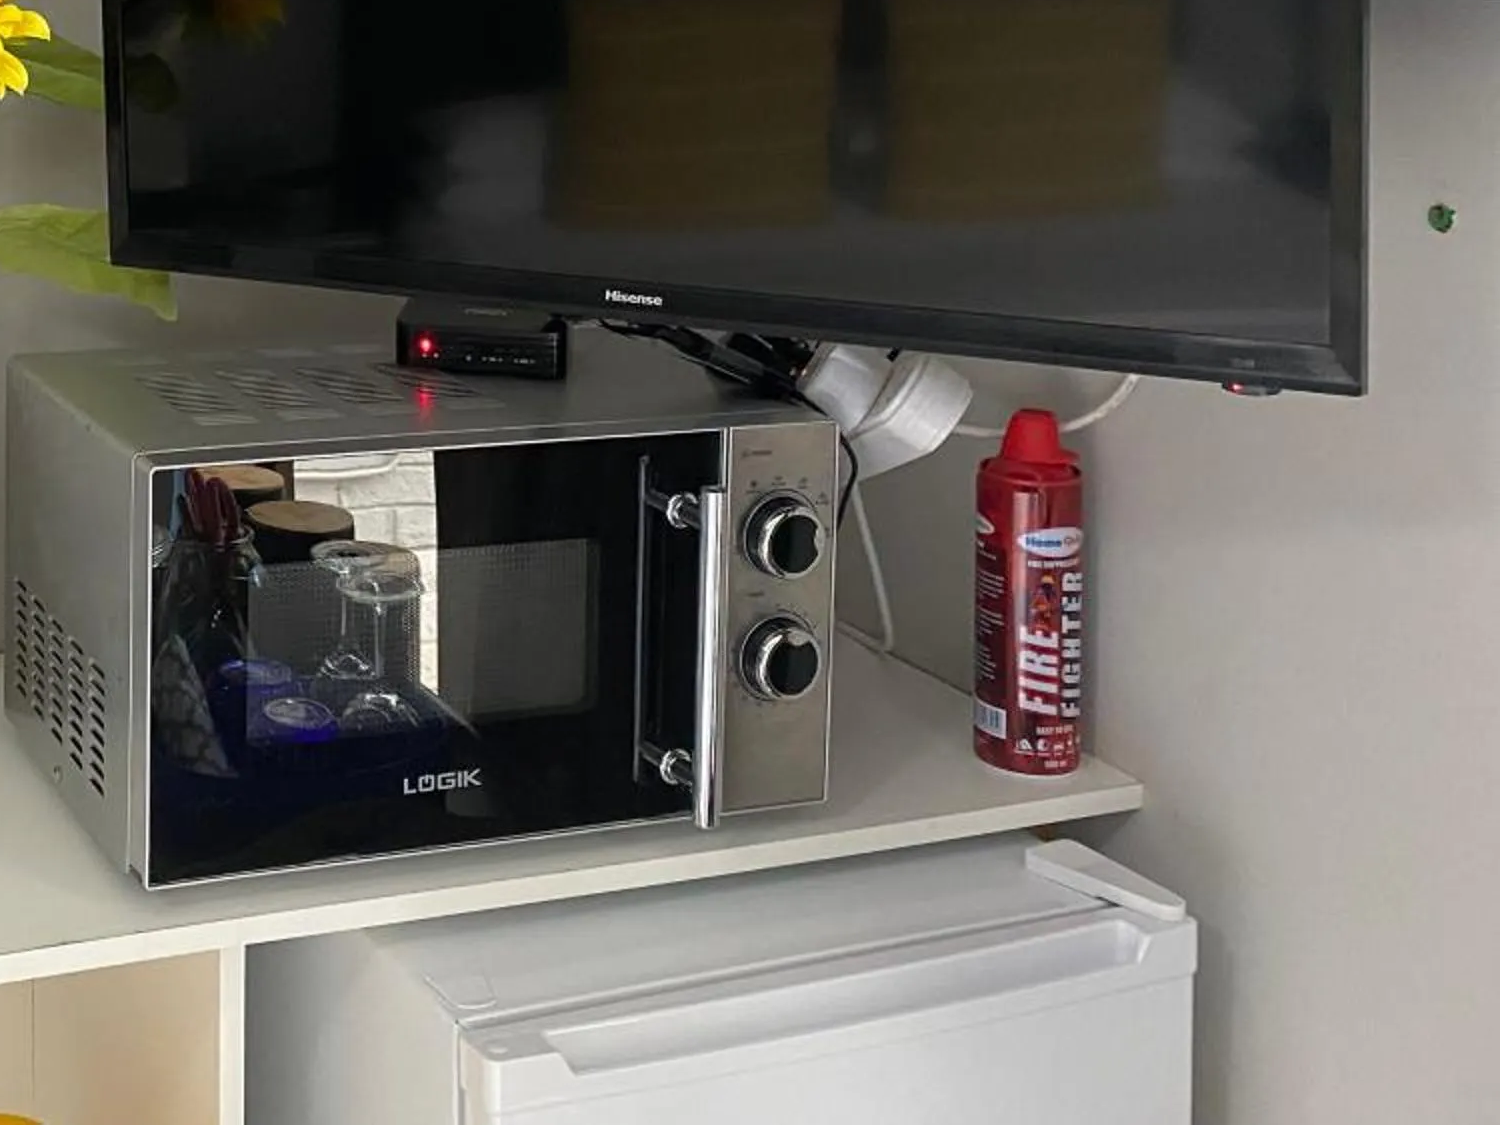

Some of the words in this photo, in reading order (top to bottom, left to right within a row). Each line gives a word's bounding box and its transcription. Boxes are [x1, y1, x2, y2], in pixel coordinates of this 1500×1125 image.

[605, 289, 663, 306] Hisense
[1018, 625, 1059, 716] FIRE
[1060, 572, 1082, 718] FIGHTER
[403, 768, 482, 795] LOGIK
